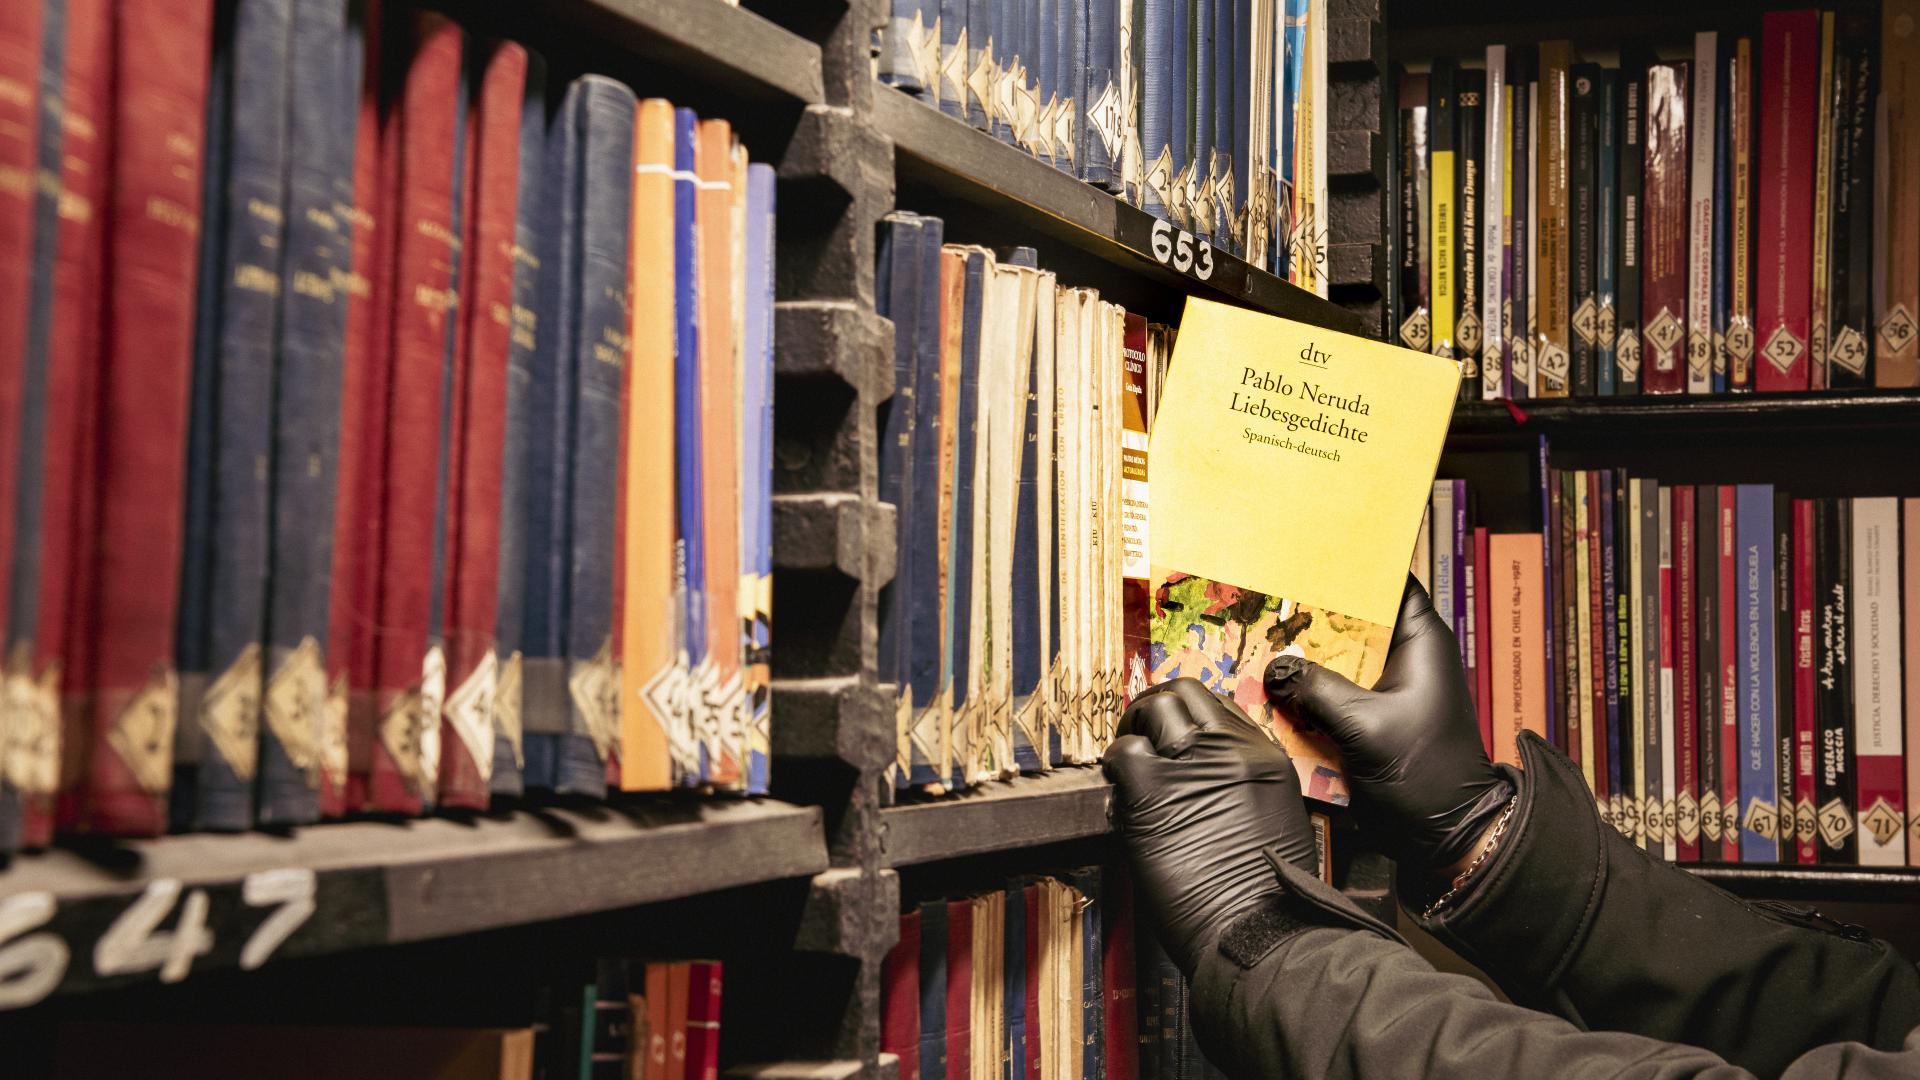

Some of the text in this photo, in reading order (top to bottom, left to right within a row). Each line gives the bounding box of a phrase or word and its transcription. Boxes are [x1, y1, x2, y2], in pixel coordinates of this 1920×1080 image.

[1151, 217, 1215, 281] 653
[1736, 207, 1745, 278] CONSTITUCIONAL
[1410, 323, 1428, 339] 35
[1462, 325, 1478, 341] 37
[1598, 319, 1614, 334] 45
[1656, 324, 1676, 341] 47
[1688, 342, 1706, 358] 48
[1734, 333, 1749, 349] 51
[1776, 340, 1795, 356] 52
[1844, 340, 1865, 360] 54
[1300, 342, 1332, 365] dtv
[1485, 356, 1502, 371] 38
[1512, 348, 1528, 365] 40
[1546, 352, 1566, 370] 42
[1621, 346, 1640, 361] 46
[1241, 367, 1370, 417] Pablo Neruda
[1057, 387, 1065, 426] CRISTO
[1229, 392, 1368, 443] Liebesgedichte
[1242, 427, 1341, 463] Spanisch-deutsch
[1058, 469, 1067, 559] IDENTIFICACION
[1680, 520, 1689, 579] ORIGINARIOS
[1060, 571, 1068, 584] DE
[1748, 545, 1759, 591] ESCUELA
[1680, 580, 1689, 619] PUEBLOS
[1749, 592, 1759, 605] LA
[1831, 583, 1845, 613] cielo
[1511, 609, 1521, 634] CHILE
[1604, 545, 1617, 705] EL GRAN LIBRO DE LOS MAGOS
[1749, 606, 1759, 621] EN
[1832, 613, 1845, 625] el
[1680, 621, 1689, 638] LOS
[1821, 604, 1833, 649] metros
[1870, 601, 1880, 650] SOCIEDAD
[1512, 636, 1521, 648] EN
[1681, 639, 1689, 652] DE
[1749, 622, 1760, 673] VIOLENCIA
[1819, 650, 1834, 676] tres
[1871, 650, 1880, 659] Y
[1512, 650, 1522, 713] PROFESORADO
[1647, 659, 1656, 694] ESENCIAL
[1682, 653, 1690, 702] PRESENTES
[1749, 674, 1759, 688] LA
[1871, 658, 1881, 704] DERECHO
[1750, 688, 1760, 712] CON
[1513, 715, 1523, 732] DEL
[1648, 695, 1657, 745] ESTRUCTURA
[1682, 710, 1691, 748] PASADAS
[1750, 713, 1760, 747] HACER
[1823, 728, 1837, 786] FEDERICO
[1834, 727, 1845, 774] MOCCIA
[1781, 737, 1792, 797] LA ARAUCANA
[1677, 805, 1697, 823] 64
[1702, 811, 1721, 828] 65
[1752, 815, 1771, 834] 67
[1796, 817, 1815, 833] 69
[1827, 812, 1846, 831] 70
[1873, 818, 1890, 834] 71
[0, 867, 317, 1012] 647
